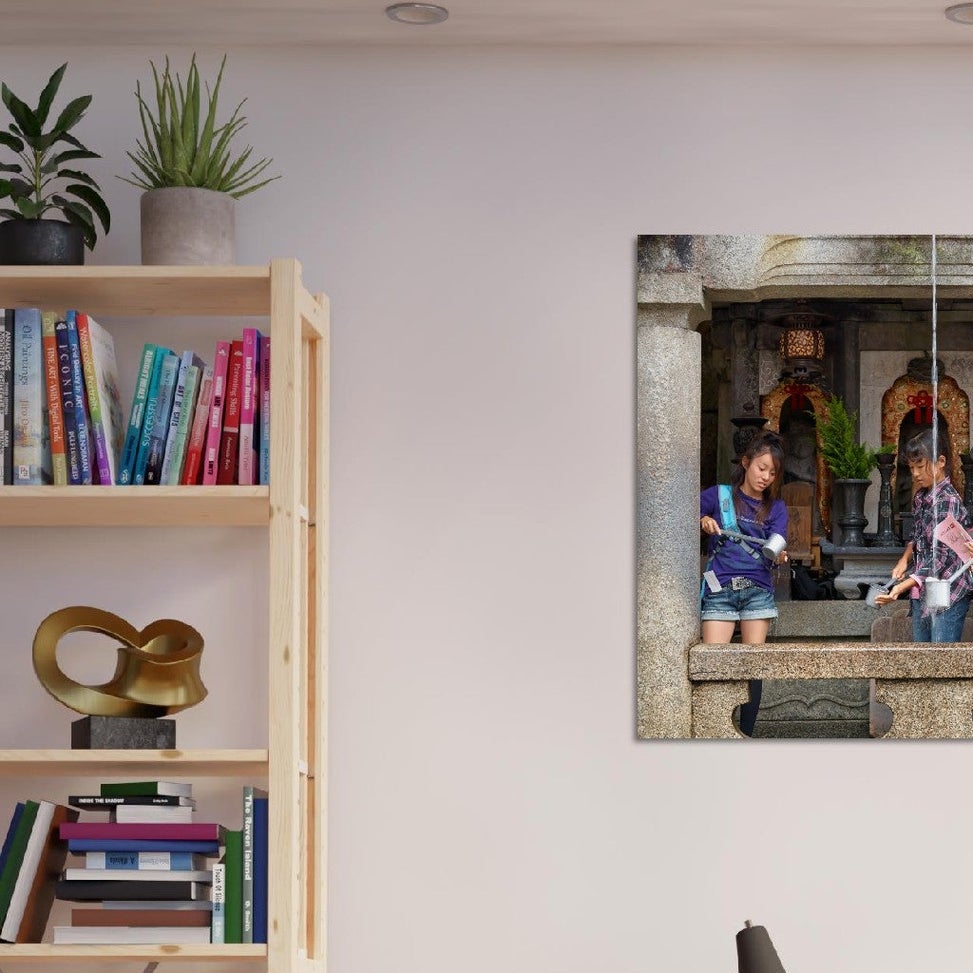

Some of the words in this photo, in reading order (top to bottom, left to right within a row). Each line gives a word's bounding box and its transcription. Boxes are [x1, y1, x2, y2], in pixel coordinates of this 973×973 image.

[21, 325, 33, 339] Oil
[19, 342, 33, 386] Paintings
[47, 347, 55, 366] FINE
[48, 365, 56, 379] ART
[59, 344, 74, 409] ICONIC
[72, 359, 81, 384] Beauty
[79, 326, 93, 374] Watercolor
[87, 375, 99, 412] Portraits
[229, 362, 241, 397] Parenting
[49, 384, 58, 401] With
[75, 394, 83, 409] ART
[49, 404, 60, 425] Digital
[228, 397, 238, 416] Skills
[52, 426, 61, 443] Tools
[244, 794, 252, 815] The
[244, 817, 252, 847] Raven
[244, 849, 252, 881] Island
